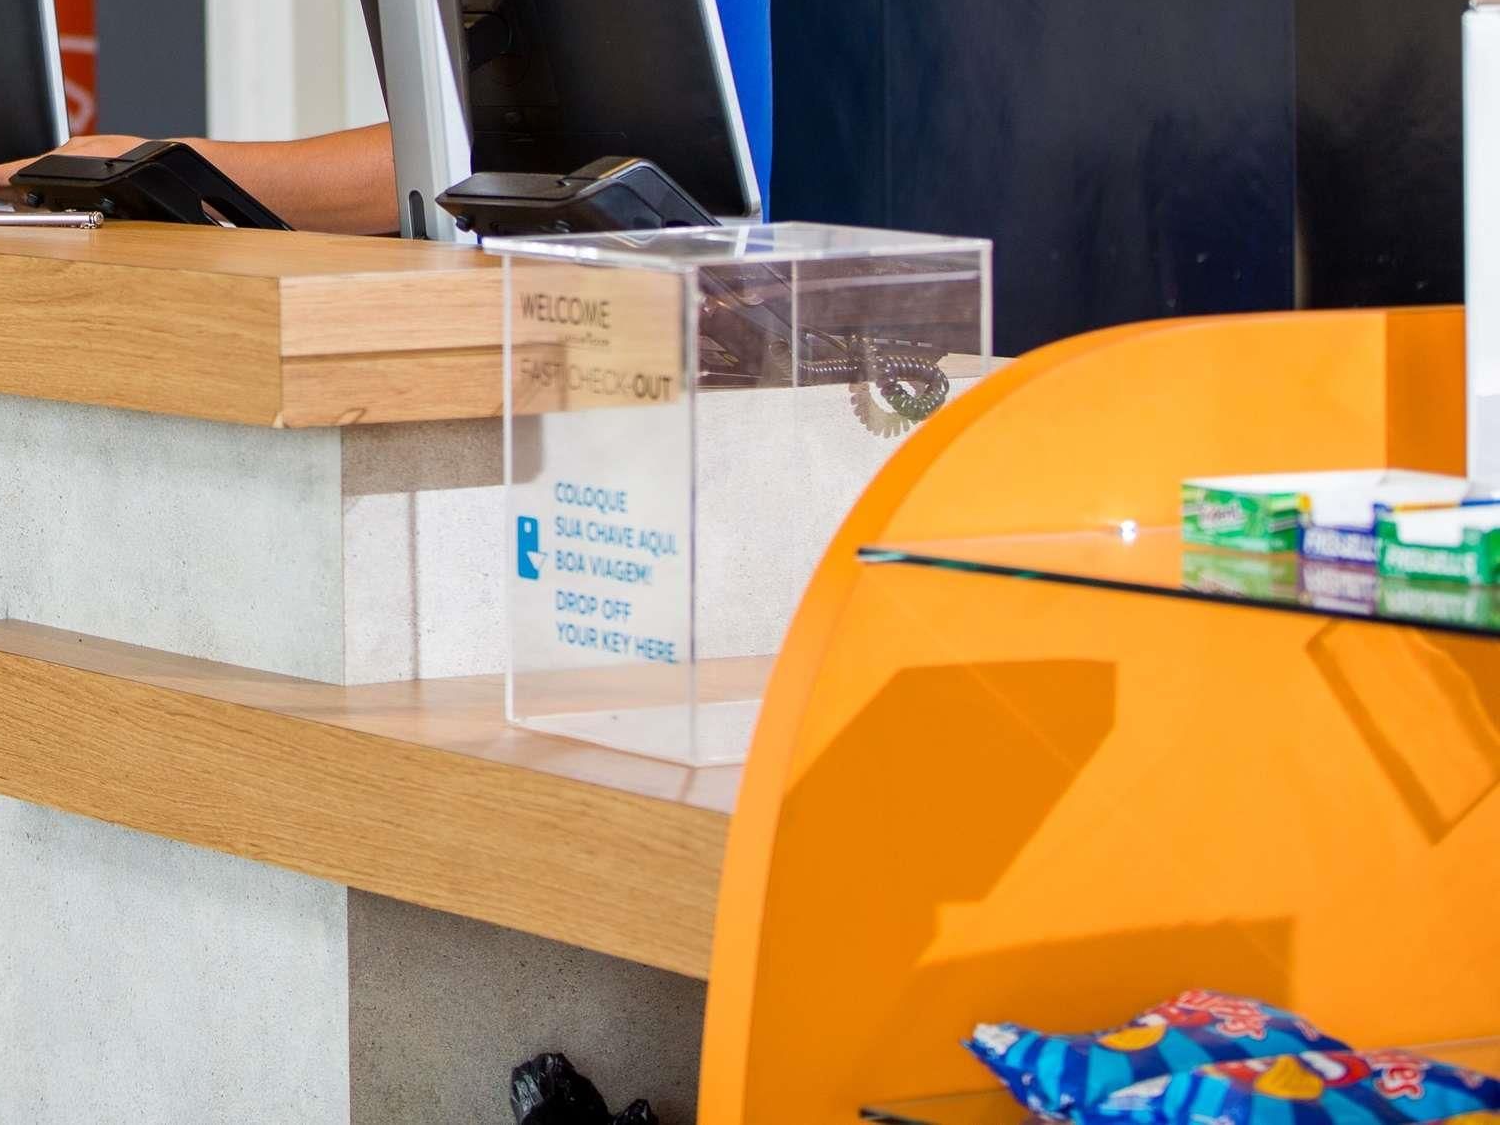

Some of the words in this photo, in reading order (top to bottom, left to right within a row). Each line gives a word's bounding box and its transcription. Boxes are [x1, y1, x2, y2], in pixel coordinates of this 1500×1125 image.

[519, 292, 611, 329] WELCOME
[555, 481, 628, 514] COLOQUE
[555, 515, 582, 539] SUA
[587, 520, 635, 549] CHAVE
[556, 549, 585, 572] BOA
[556, 589, 597, 615] DROP
[602, 598, 633, 622] OFF
[555, 621, 597, 648] YOUR
[602, 630, 633, 654] KEY
